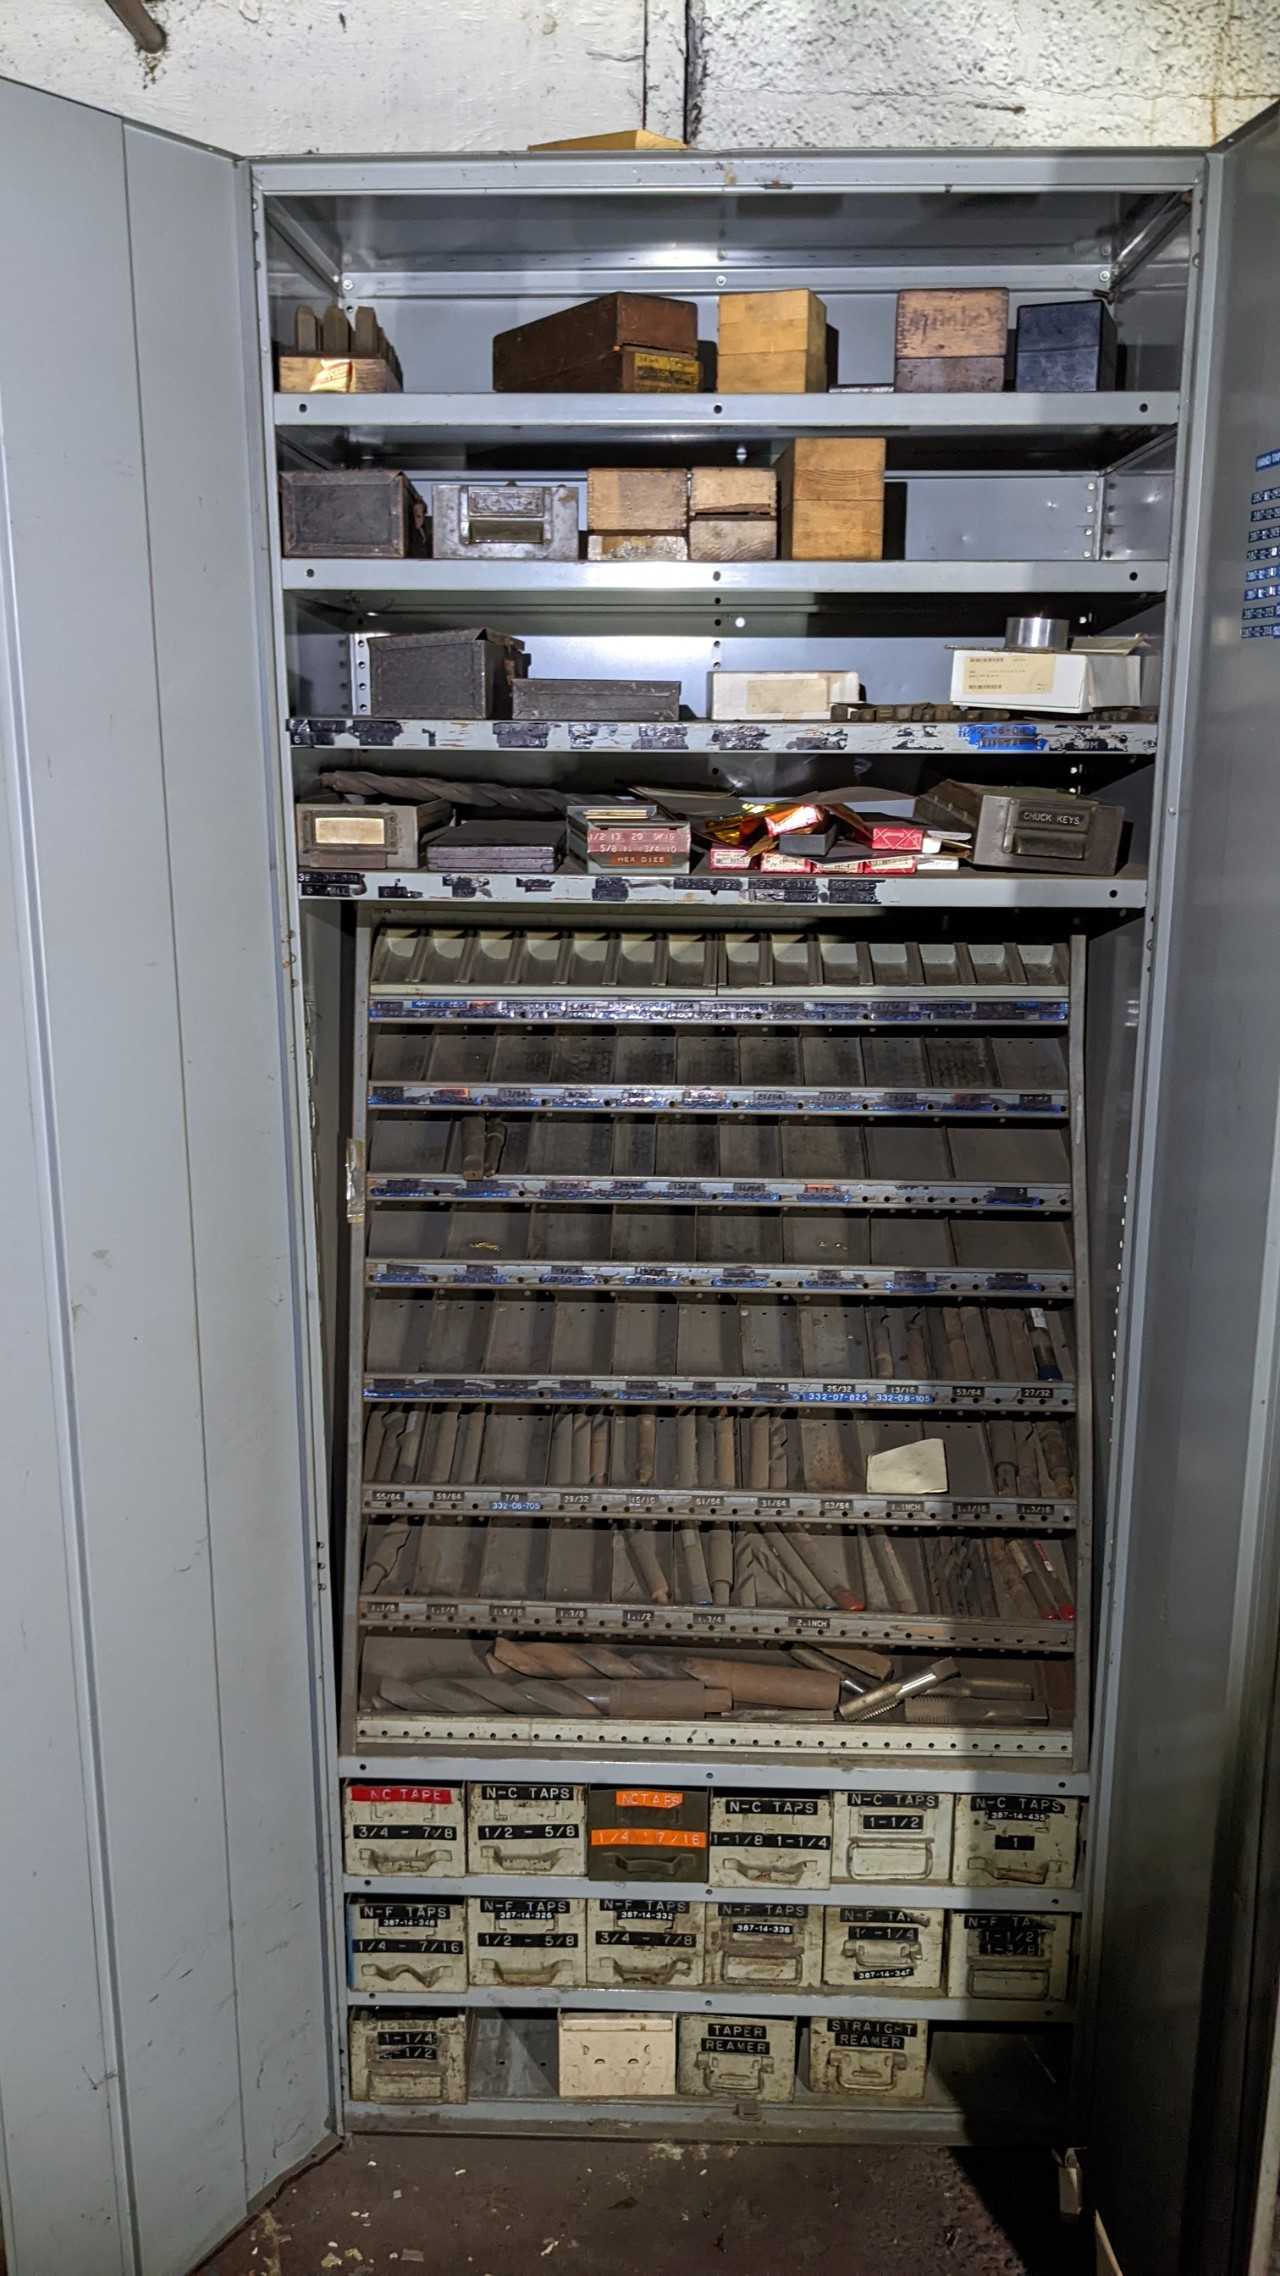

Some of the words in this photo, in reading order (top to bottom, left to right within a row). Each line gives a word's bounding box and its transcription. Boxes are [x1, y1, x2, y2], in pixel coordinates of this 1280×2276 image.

[1023, 811, 1052, 822] CHUCK
[1056, 815, 1081, 825] KEYS
[826, 1385, 852, 1393] 25/32
[370, 1788, 392, 1800] NC
[486, 1786, 517, 1799] N-C
[529, 1787, 571, 1800] TAPS
[851, 1793, 882, 1805] N-C
[895, 1794, 936, 1807] TAPS
[976, 1797, 1006, 1809] N-C
[1020, 1798, 1062, 1812] TAPS
[729, 1801, 762, 1813] N-C
[776, 1802, 815, 1814] TAPS
[868, 1816, 920, 1829] 1-1/2
[358, 1826, 389, 1839] 3/4
[422, 1827, 454, 1839] 7/8
[485, 1827, 513, 1839] 1/2
[545, 1826, 577, 1838] 5/8
[598, 1832, 630, 1844] 1/4
[713, 1833, 764, 1846] 1-1/8
[777, 1836, 828, 1849] 1-1/4
[363, 1905, 393, 1918] N-F
[406, 1906, 447, 1918] TAPS
[484, 1900, 515, 1912] N-F
[527, 1901, 567, 1913] TAPS
[600, 1899, 633, 1911] N-F
[647, 1900, 687, 1913] TAPS
[722, 1904, 753, 1916] N-F
[764, 1904, 806, 1916] TAPS
[845, 1909, 873, 1921] N-F
[968, 1916, 997, 1928] N-F
[484, 1934, 513, 1946] 1/2
[545, 1934, 575, 1947] 5/8
[600, 1933, 630, 1945] 3/4
[663, 1934, 694, 1946] 7/8
[359, 1942, 387, 1953] 1/4
[419, 1942, 460, 1954] 7/16
[713, 2024, 763, 2038] TAPER
[383, 2032, 434, 2044] 1-1/4
[839, 2033, 902, 2048] REAMER
[705, 2040, 767, 2054] REAMER
